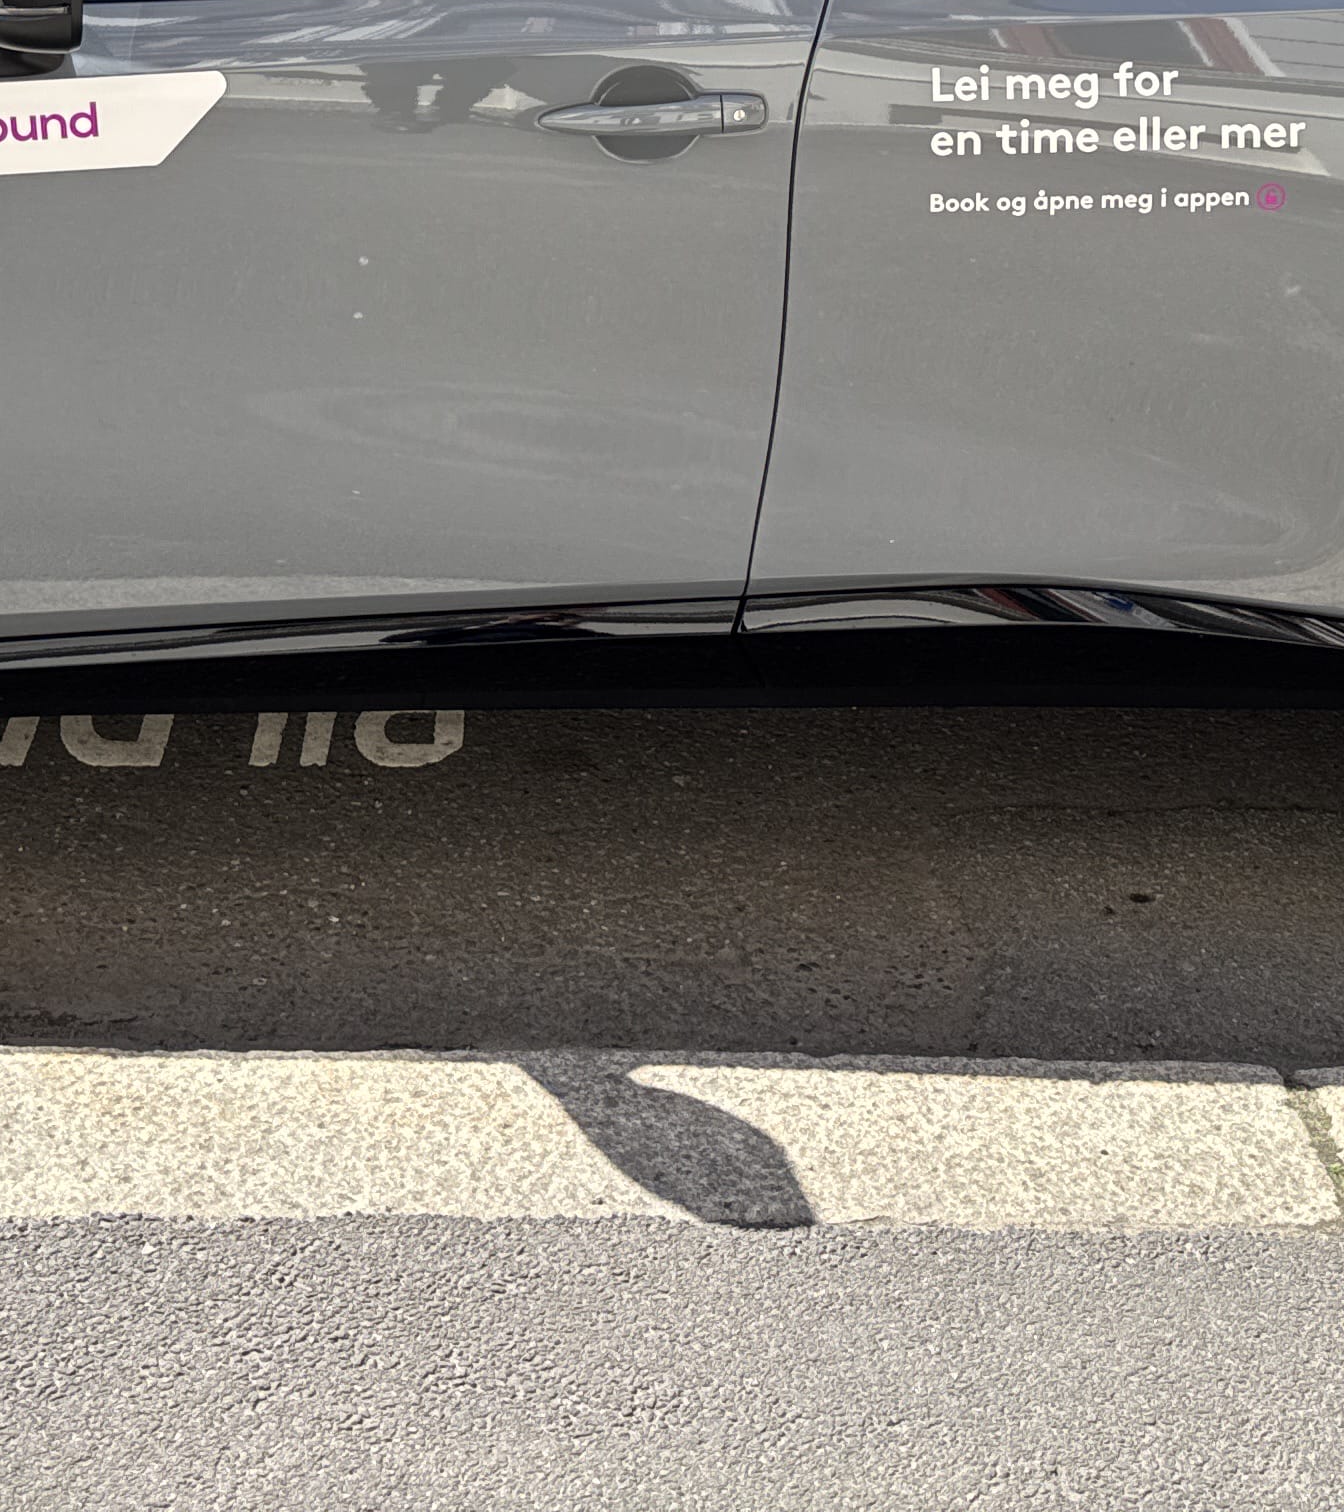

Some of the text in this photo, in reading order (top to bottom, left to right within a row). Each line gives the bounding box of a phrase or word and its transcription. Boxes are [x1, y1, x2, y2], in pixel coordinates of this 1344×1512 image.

[931, 61, 1179, 109] Lei meg for
[930, 116, 1306, 156] en time eller mer
[930, 187, 1249, 216] Book og åpne meg i appen
